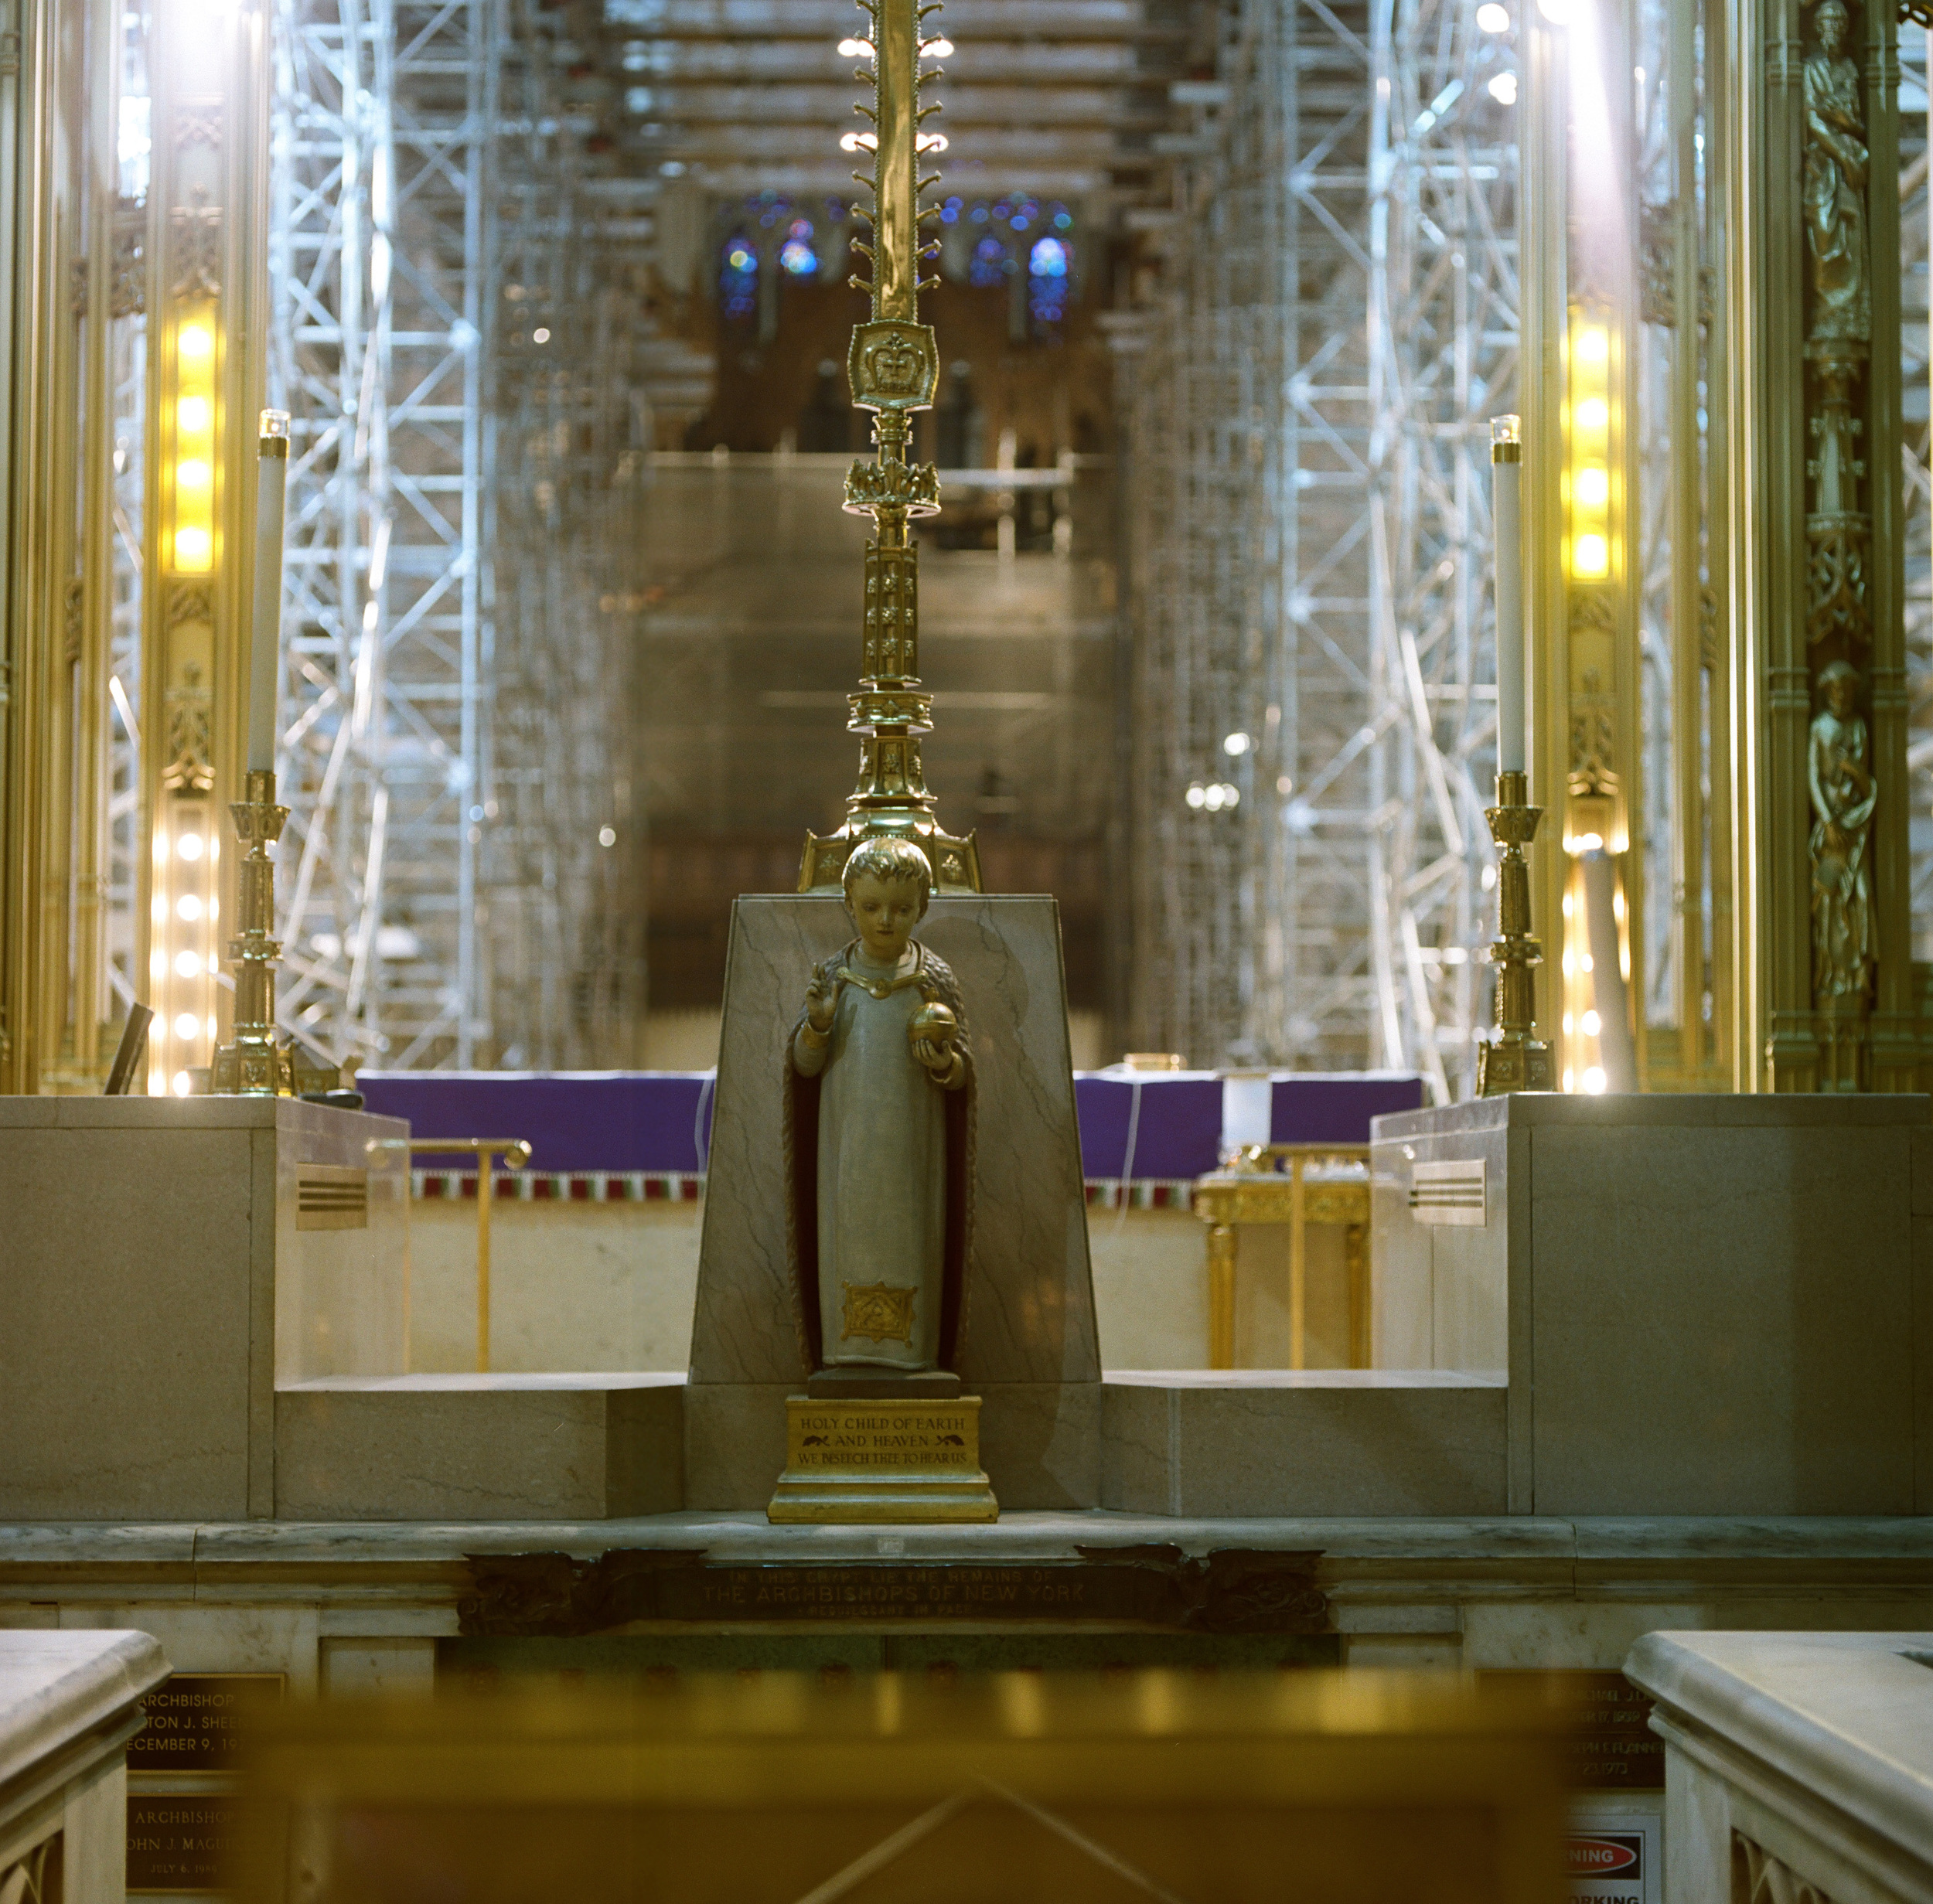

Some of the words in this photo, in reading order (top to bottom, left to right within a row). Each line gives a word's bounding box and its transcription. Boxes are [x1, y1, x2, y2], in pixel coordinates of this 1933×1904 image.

[800, 1418, 840, 1430] HOLY
[844, 1418, 889, 1430] CHILD
[892, 1418, 912, 1430] OF
[916, 1418, 965, 1430] EARTH
[834, 1435, 866, 1447] AND
[873, 1435, 929, 1447] HEAVEN
[798, 1453, 817, 1465] WE
[821, 1453, 869, 1465] BESEECH
[872, 1453, 899, 1465] THEE
[902, 1453, 919, 1464] TO
[919, 1453, 951, 1464] HEAR
[951, 1453, 967, 1463] US
[870, 1571, 896, 1583] LIE
[906, 1570, 938, 1582] THE
[948, 1570, 1022, 1582] REMAINS
[1032, 1570, 1053, 1582] OF
[702, 1586, 746, 1603] THE
[755, 1586, 919, 1603] ARCHBISHOPS
[929, 1585, 956, 1601] OF
[965, 1585, 1018, 1601] NEW
[1027, 1583, 1085, 1602] YORK
[145, 1716, 179, 1729] TON
[183, 1716, 196, 1729] J.
[126, 1738, 196, 1751] ECEMBER
[201, 1738, 215, 1752] 9,
[126, 1838, 161, 1851] OHN
[166, 1838, 177, 1851] J.
[1569, 1849, 1614, 1863] NING
[151, 1864, 176, 1874] JULY
